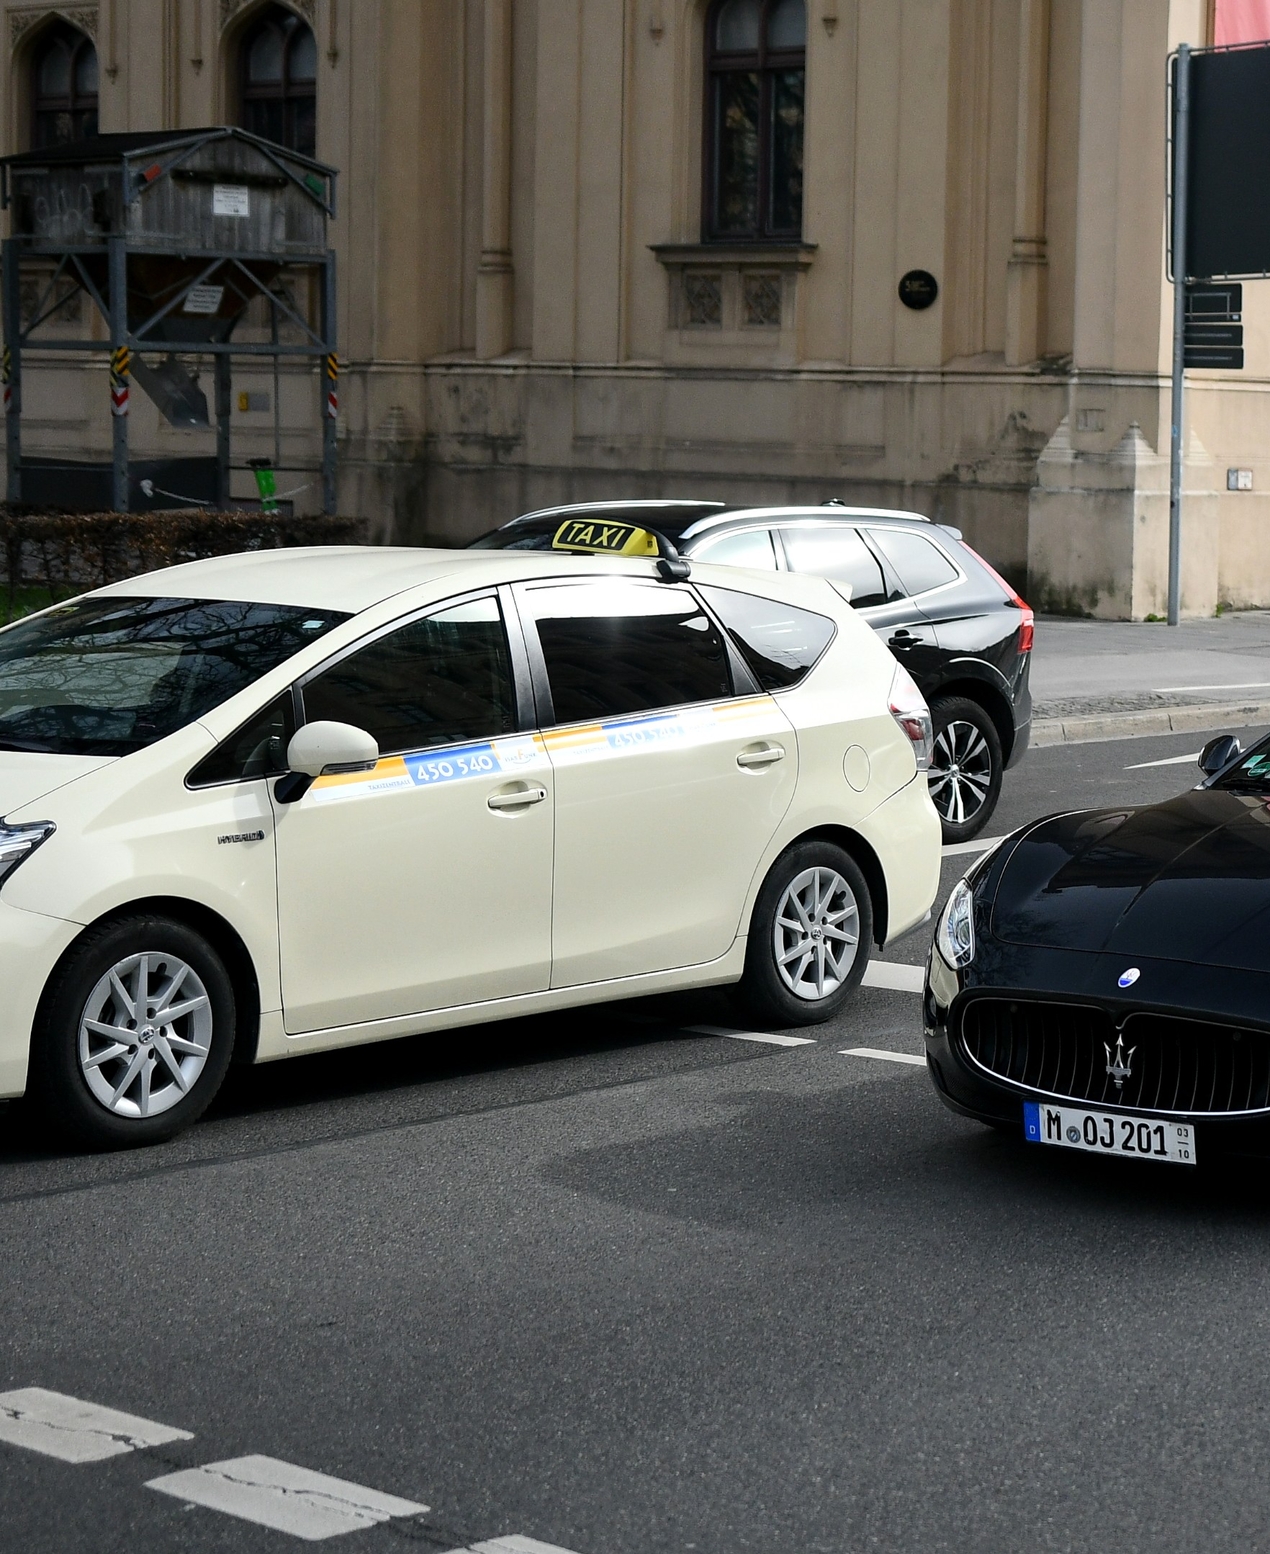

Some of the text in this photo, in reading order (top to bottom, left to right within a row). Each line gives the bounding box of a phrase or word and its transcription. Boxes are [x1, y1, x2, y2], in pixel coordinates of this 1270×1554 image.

[566, 523, 626, 547] TAXI
[613, 732, 645, 748] 450
[649, 725, 681, 741] 540
[417, 761, 453, 782] 450
[457, 755, 493, 774] 540
[217, 832, 259, 845] HYBRID
[1029, 1125, 1036, 1134] D
[1046, 1109, 1062, 1141] M
[1121, 1120, 1168, 1156] 201
[1177, 1127, 1189, 1138] 03
[1178, 1149, 1190, 1159] 10
